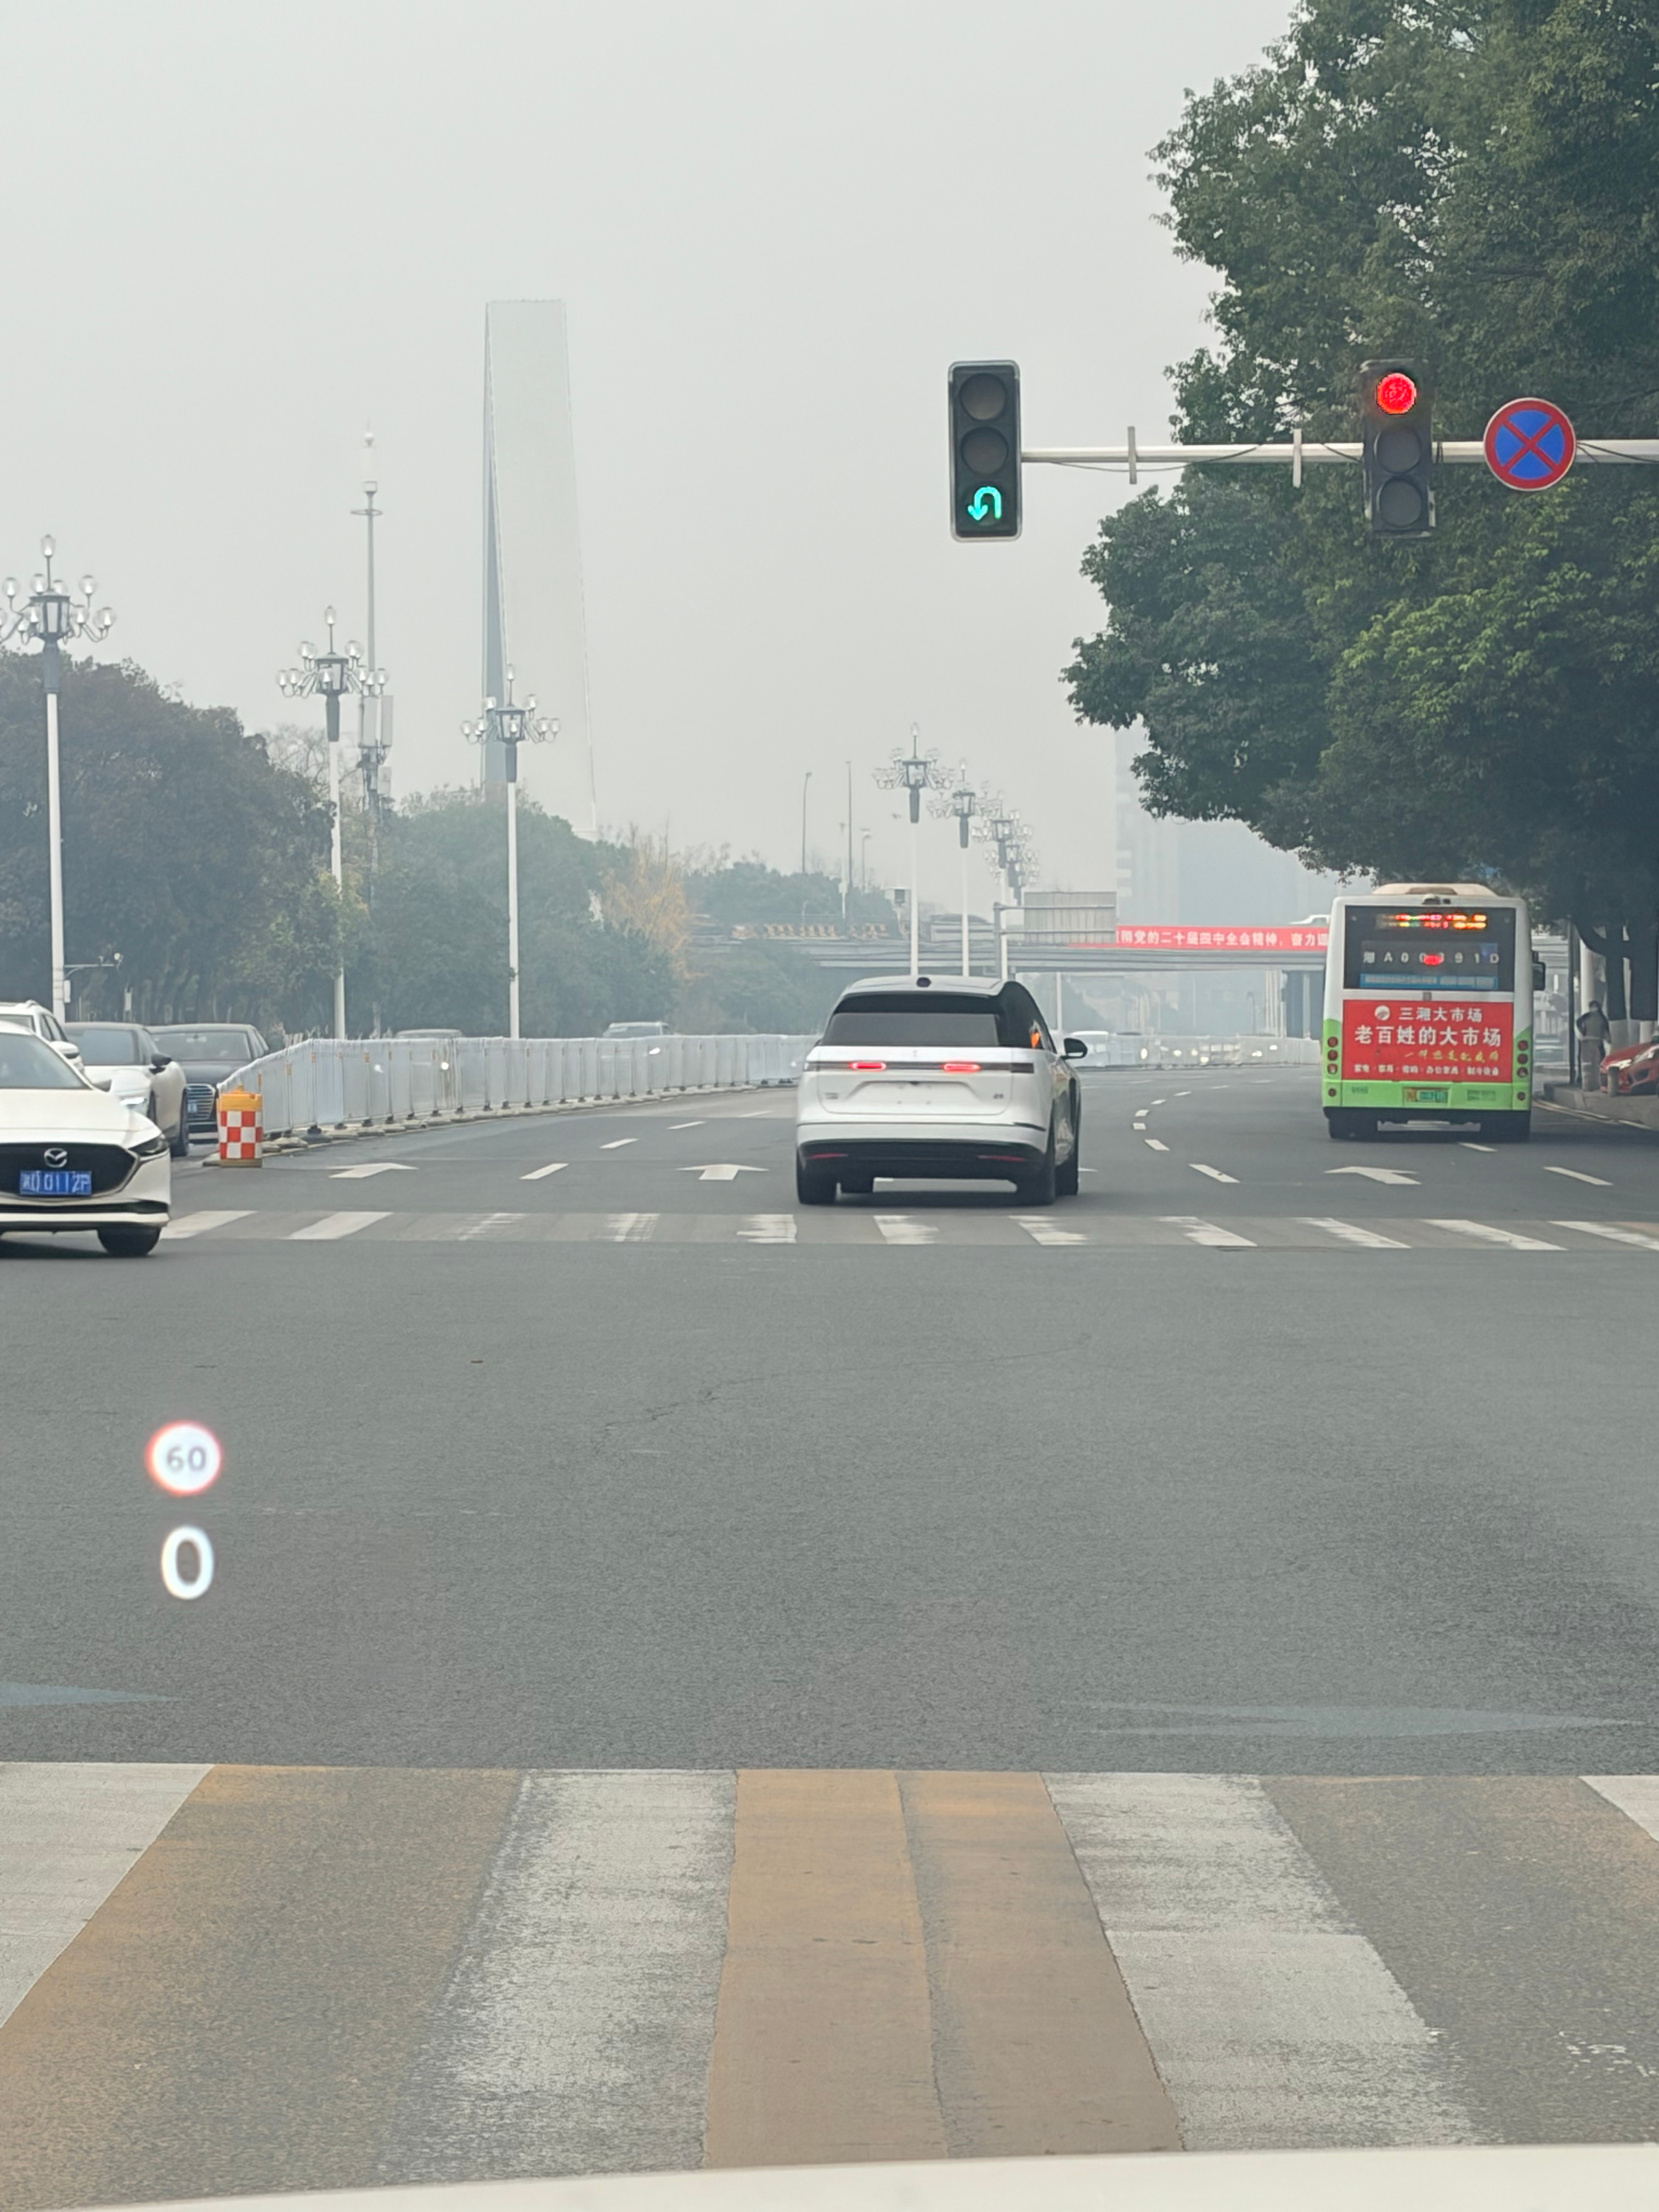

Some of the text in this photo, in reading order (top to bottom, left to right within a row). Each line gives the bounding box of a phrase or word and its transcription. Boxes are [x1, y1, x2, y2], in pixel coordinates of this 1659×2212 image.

[1398, 1007, 1482, 1023] 三湘大市场
[1355, 1025, 1501, 1047] 老百姓的大市场
[167, 1446, 207, 1472] 60
[161, 1525, 215, 1600] 0
